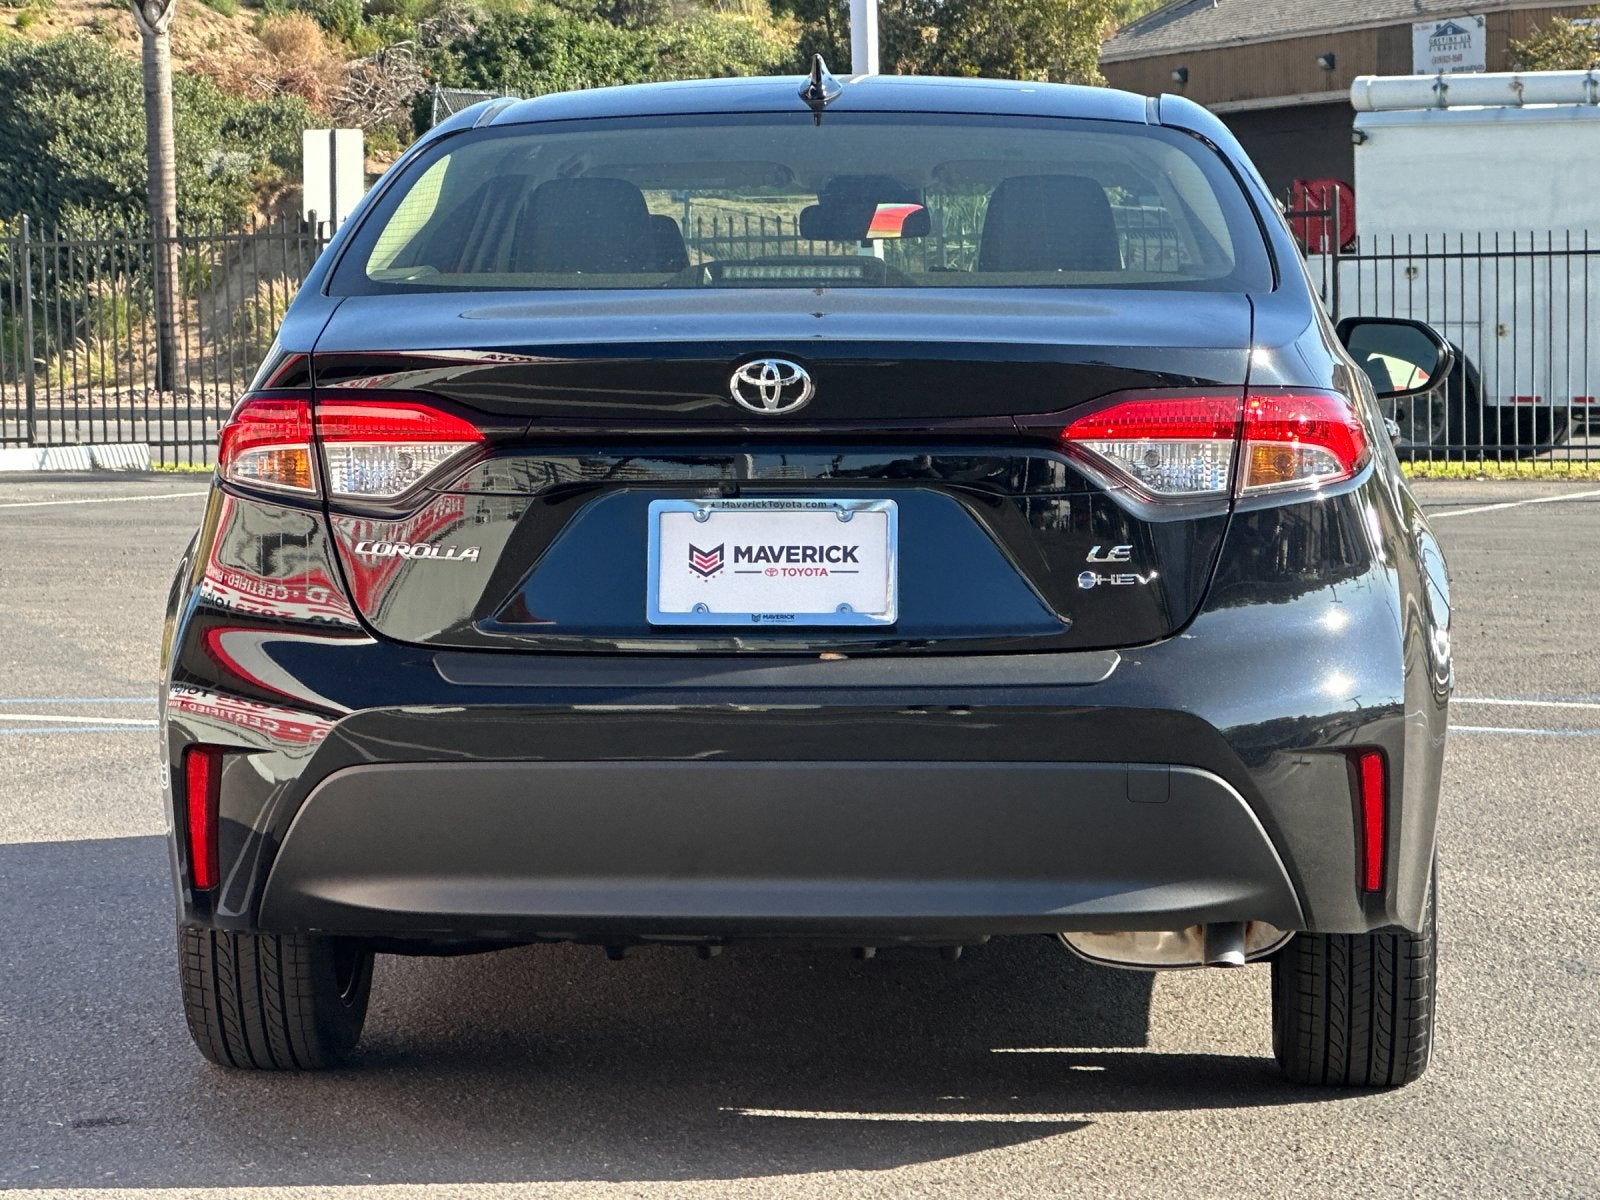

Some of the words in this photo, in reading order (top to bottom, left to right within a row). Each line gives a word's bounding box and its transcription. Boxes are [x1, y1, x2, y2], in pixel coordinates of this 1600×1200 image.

[721, 500, 827, 509] MaverickToyota.com
[354, 540, 481, 562] COROLLA
[733, 545, 859, 563] MAVERICK
[1086, 545, 1133, 562] LE
[781, 567, 828, 577] TOYOTA
[1097, 570, 1158, 585] HEV
